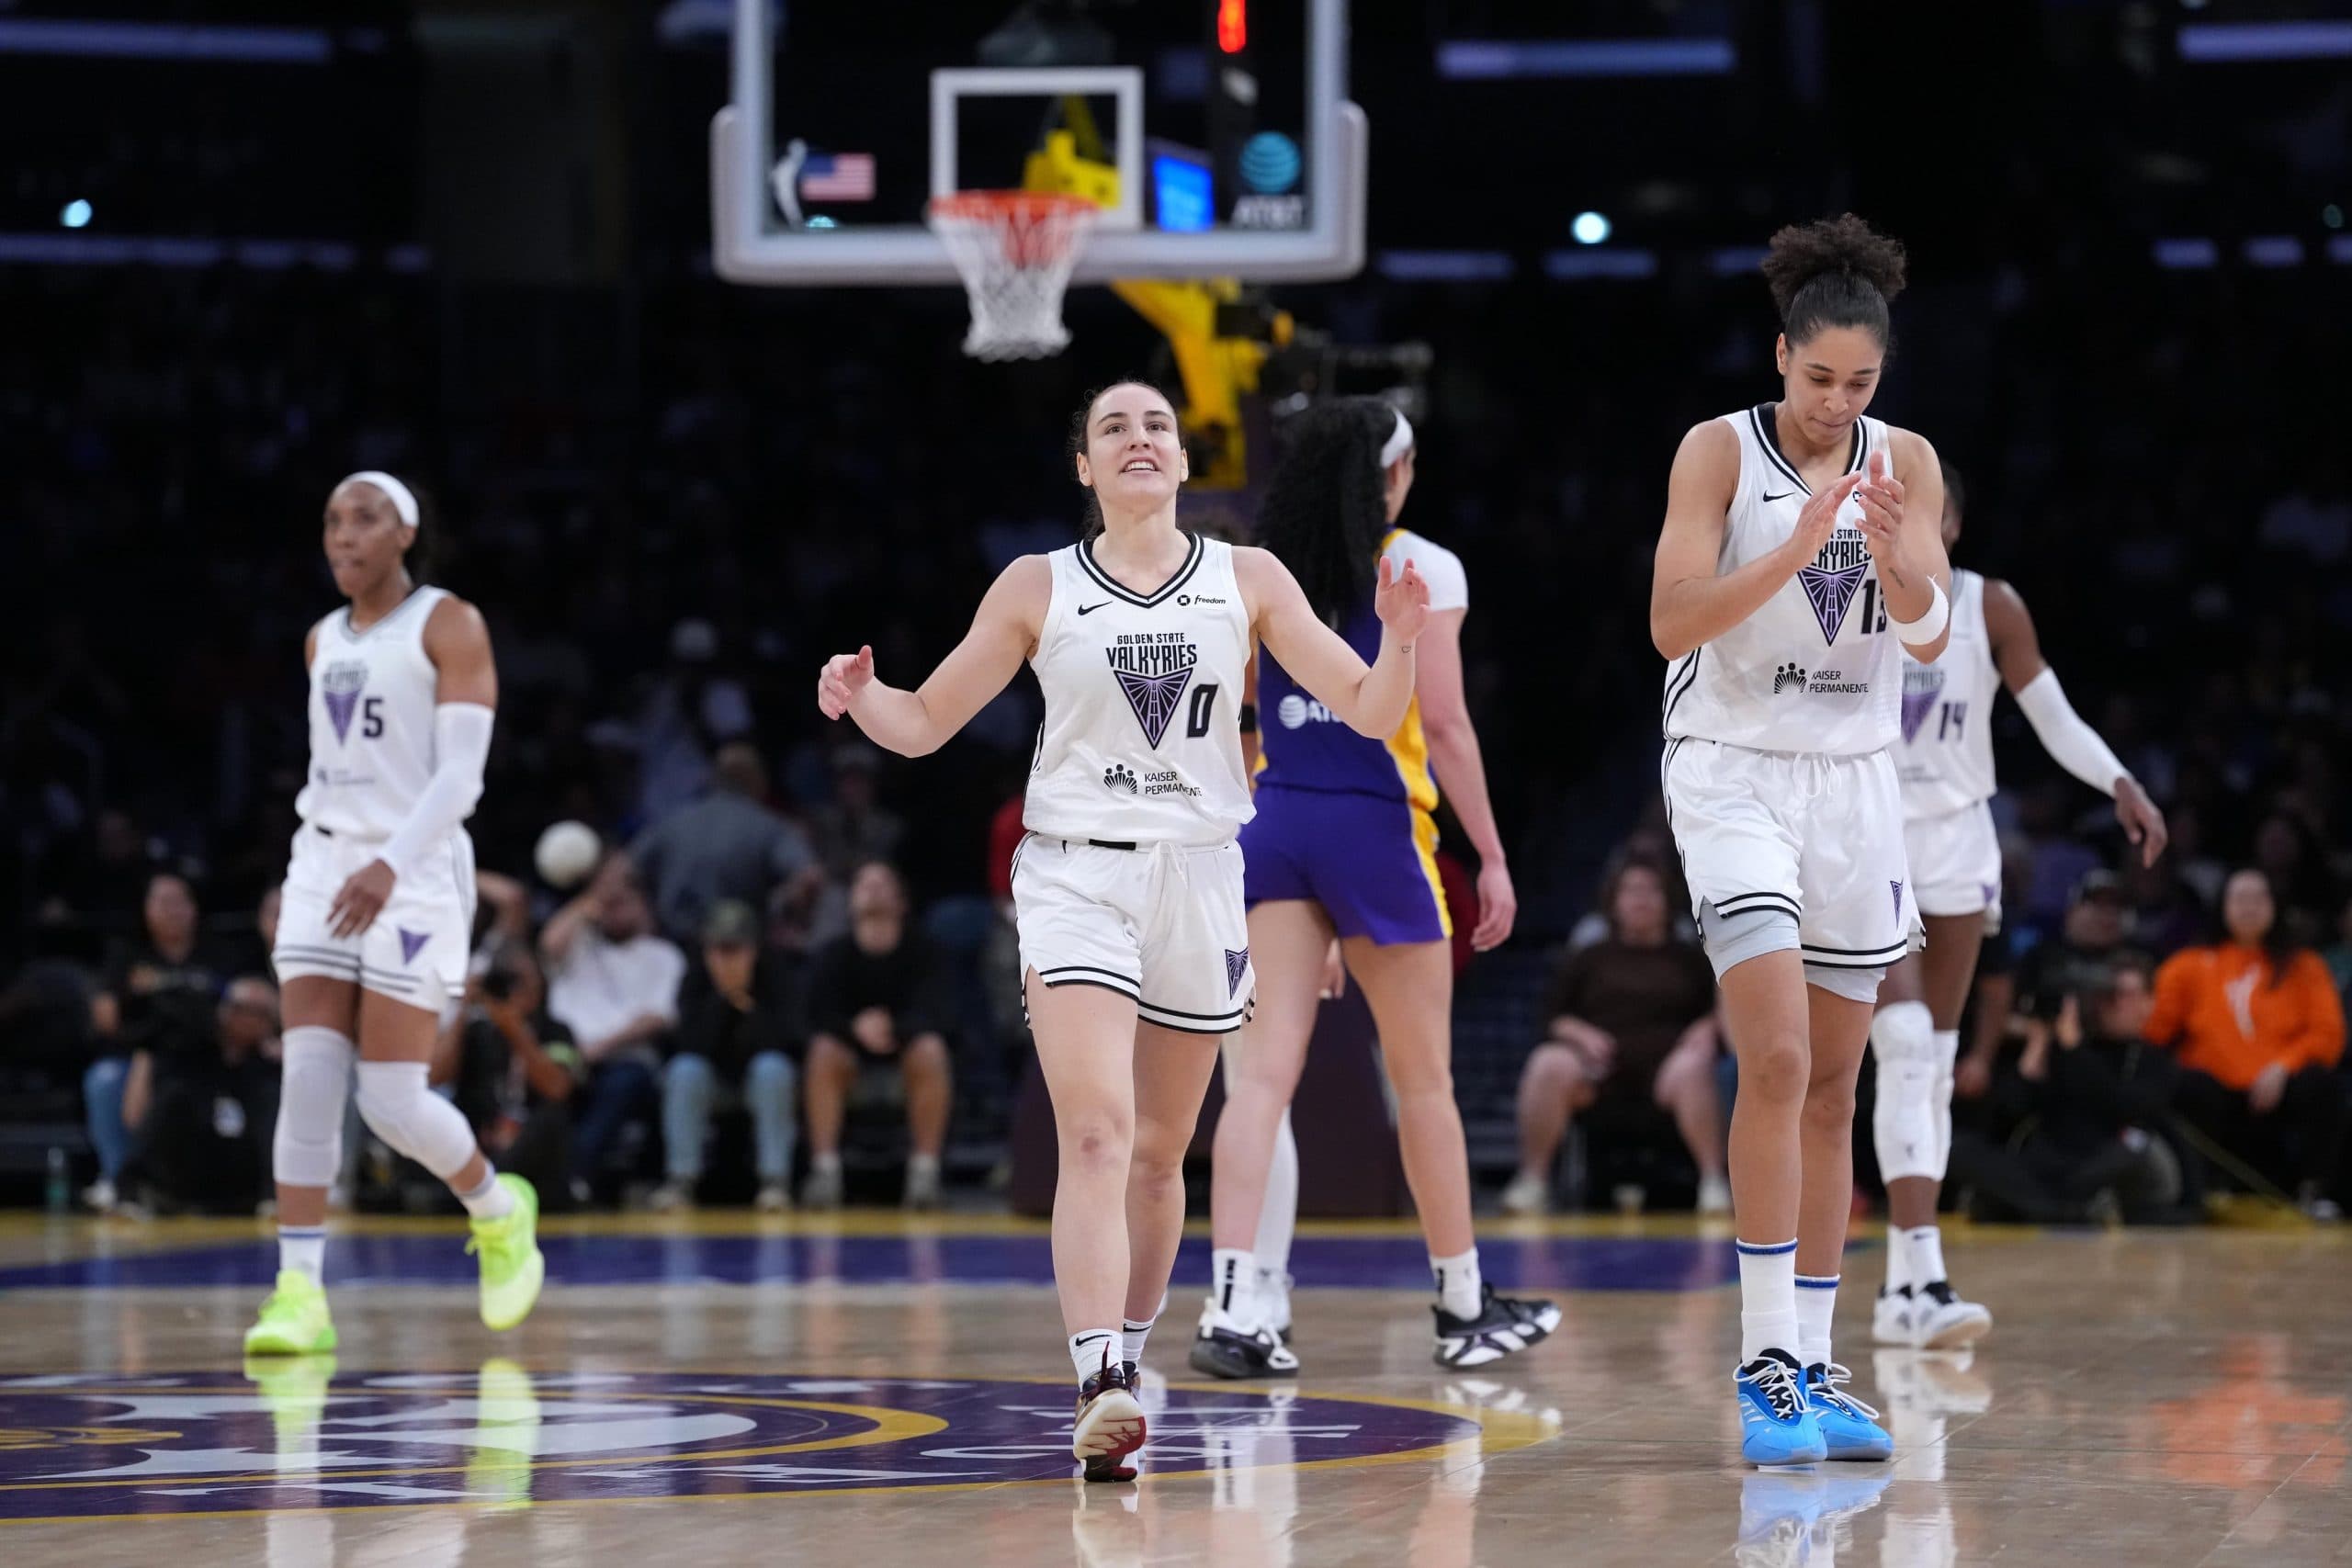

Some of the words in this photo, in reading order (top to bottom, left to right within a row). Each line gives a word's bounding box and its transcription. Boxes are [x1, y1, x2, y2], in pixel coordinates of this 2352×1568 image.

[1811, 541, 1872, 571] KYRIES
[1194, 595, 1226, 604] freedom
[1117, 634, 1153, 645] GOLDEN
[1156, 632, 1185, 643] STATE
[1105, 644, 1197, 676] VALKYRIES
[1809, 682, 1869, 694] PERMANENTE
[363, 697, 385, 739] 5
[1186, 683, 1218, 739] 0
[1939, 702, 1968, 741] 14
[1145, 772, 1178, 782] KAISER
